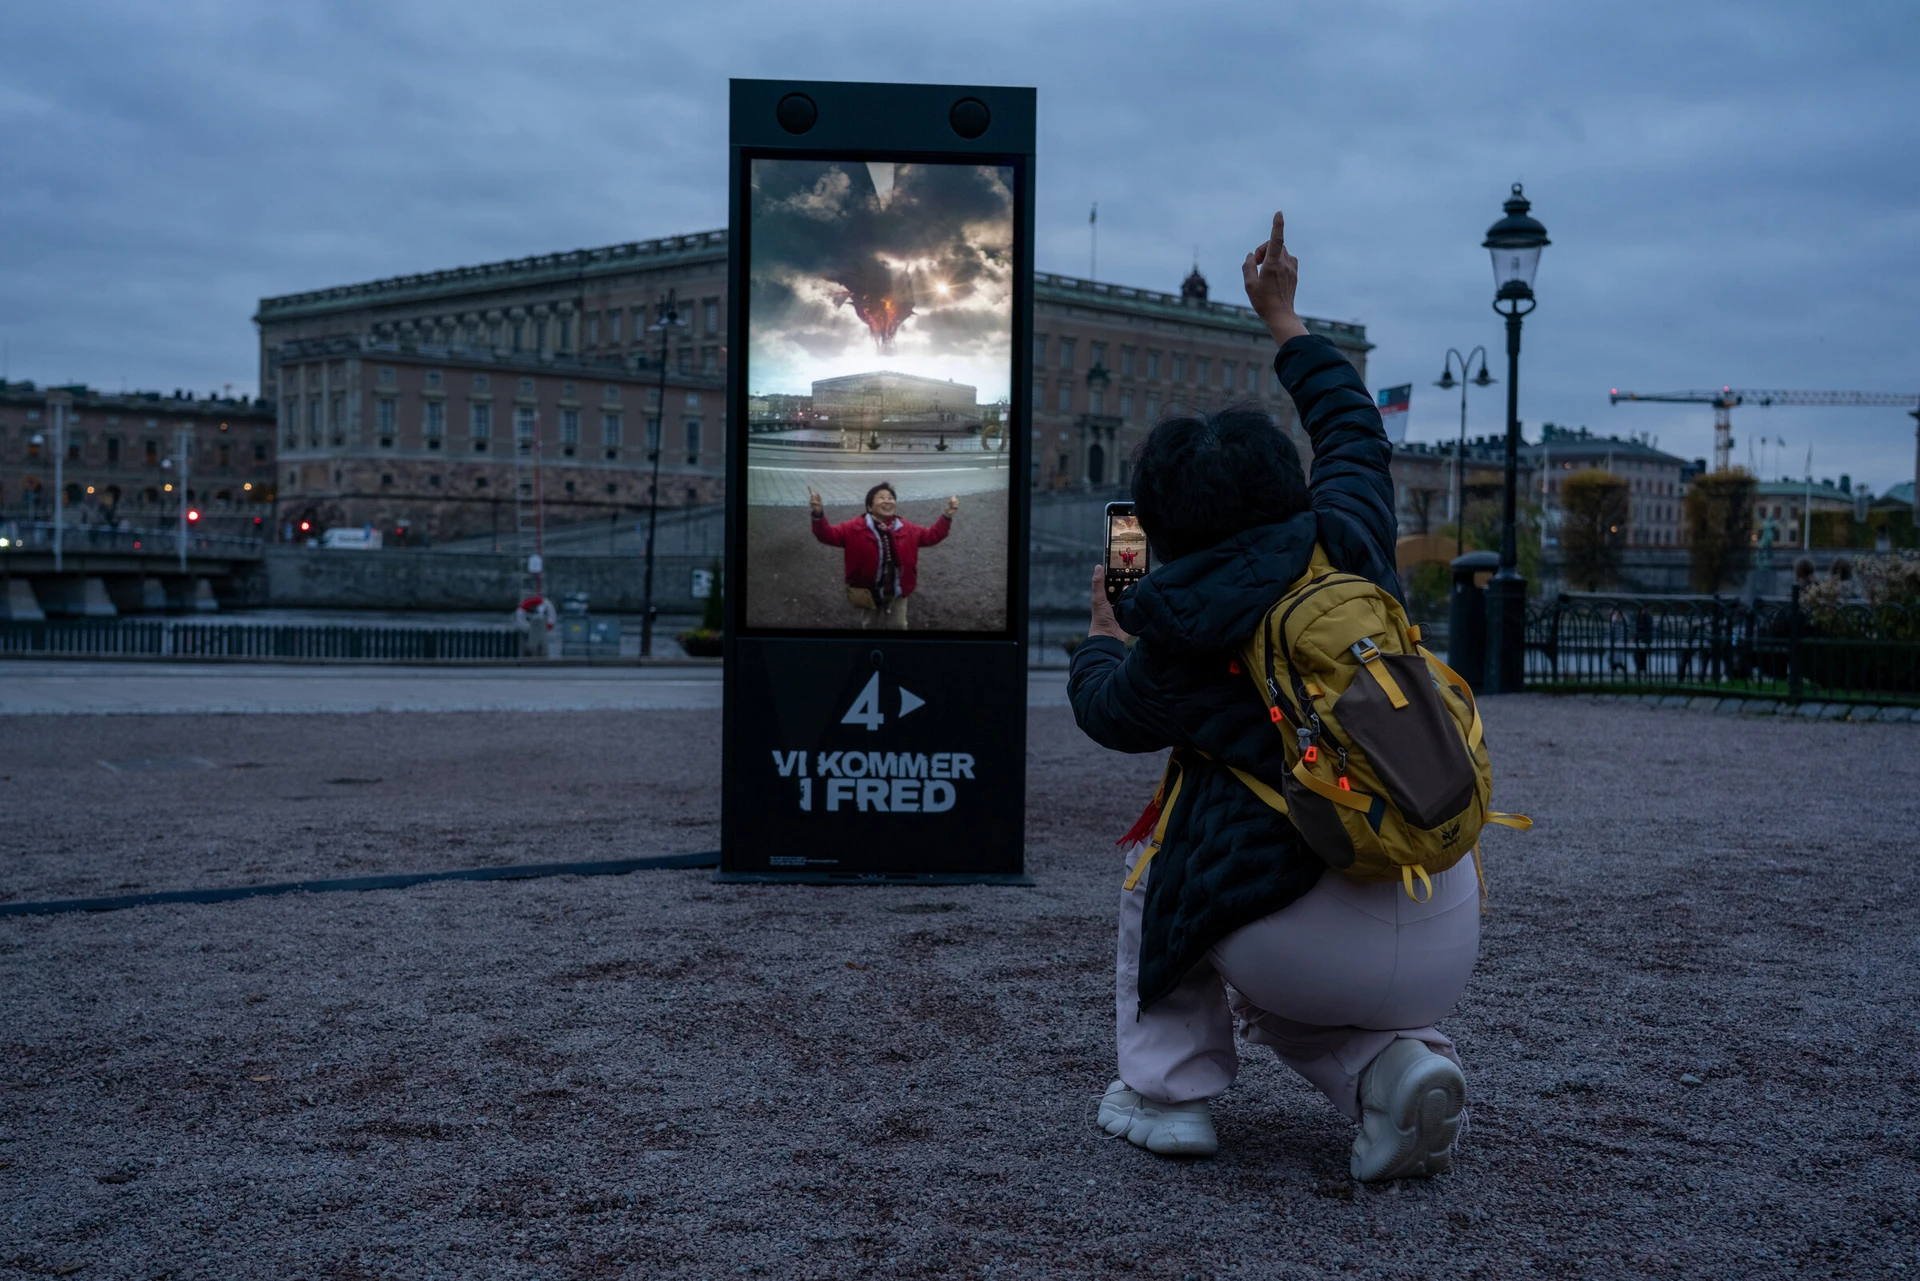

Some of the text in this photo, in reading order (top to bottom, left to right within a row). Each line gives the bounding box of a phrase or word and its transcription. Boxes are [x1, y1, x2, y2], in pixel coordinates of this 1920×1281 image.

[840, 670, 885, 731] 4
[771, 750, 976, 779] VI KOMMER
[799, 777, 957, 814] I FRED
